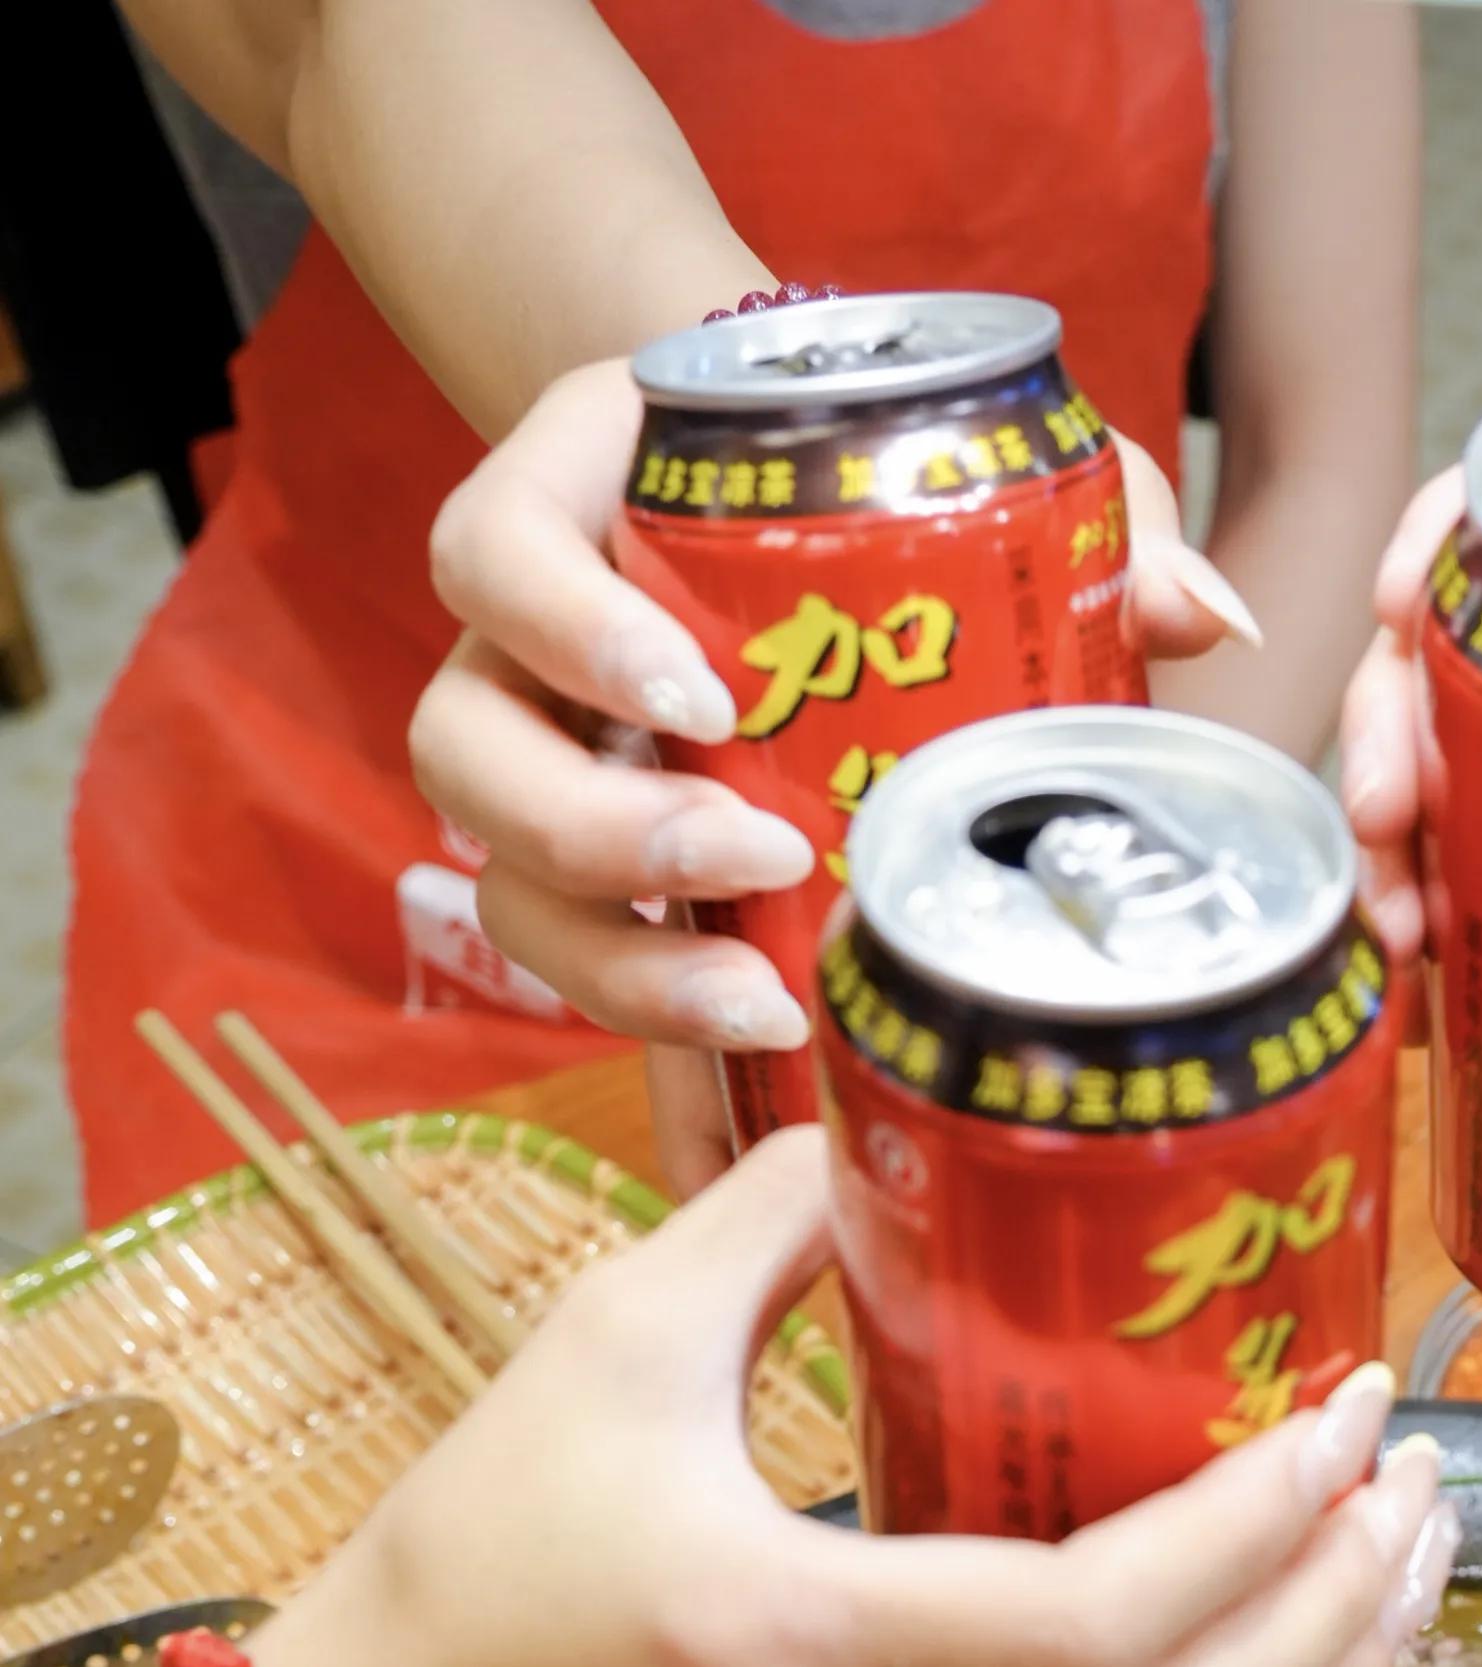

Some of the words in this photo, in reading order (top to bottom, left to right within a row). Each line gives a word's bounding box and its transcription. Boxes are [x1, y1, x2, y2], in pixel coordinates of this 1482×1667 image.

[971, 1057, 1213, 1125] 加多宝凉茶
